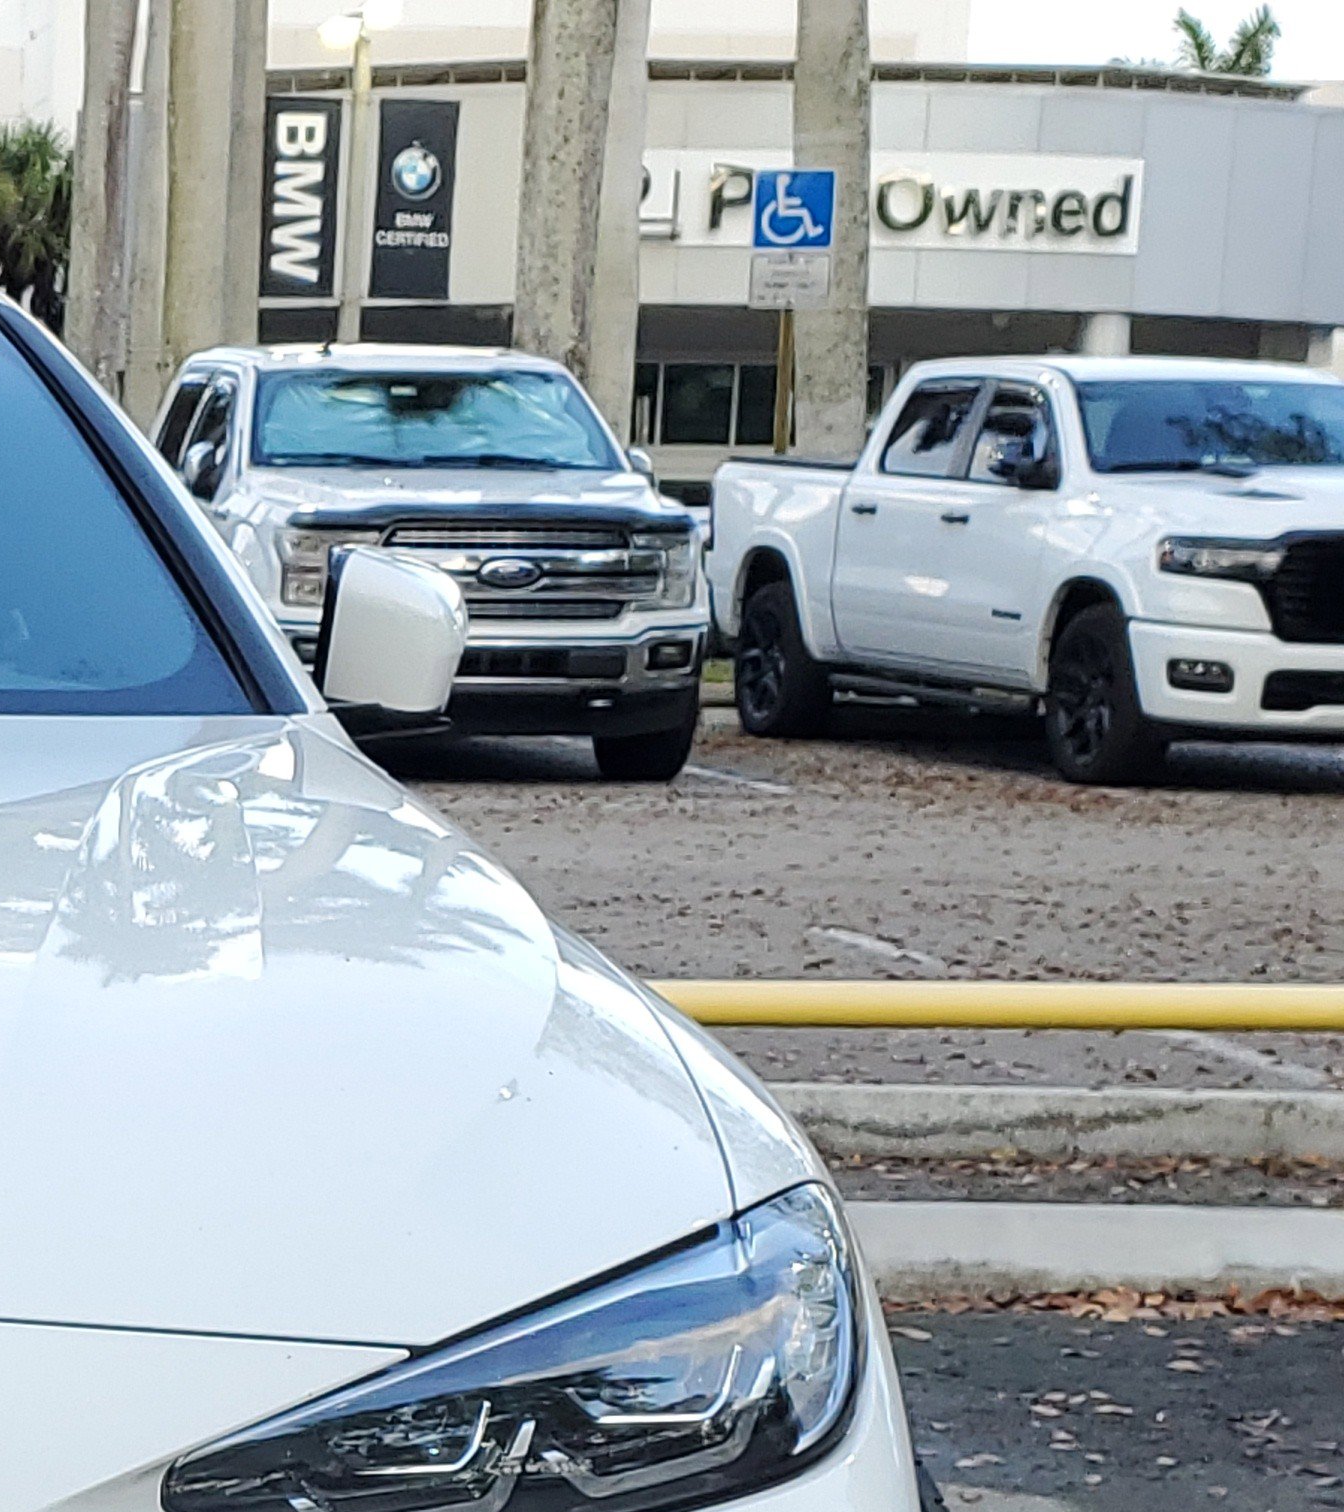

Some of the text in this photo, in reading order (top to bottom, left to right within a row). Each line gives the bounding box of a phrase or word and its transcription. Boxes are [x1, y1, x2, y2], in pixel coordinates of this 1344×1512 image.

[270, 113, 327, 283] BMW
[395, 211, 434, 229] BMW
[876, 168, 1134, 241] Owned
[375, 230, 449, 248] CERTIFIED
